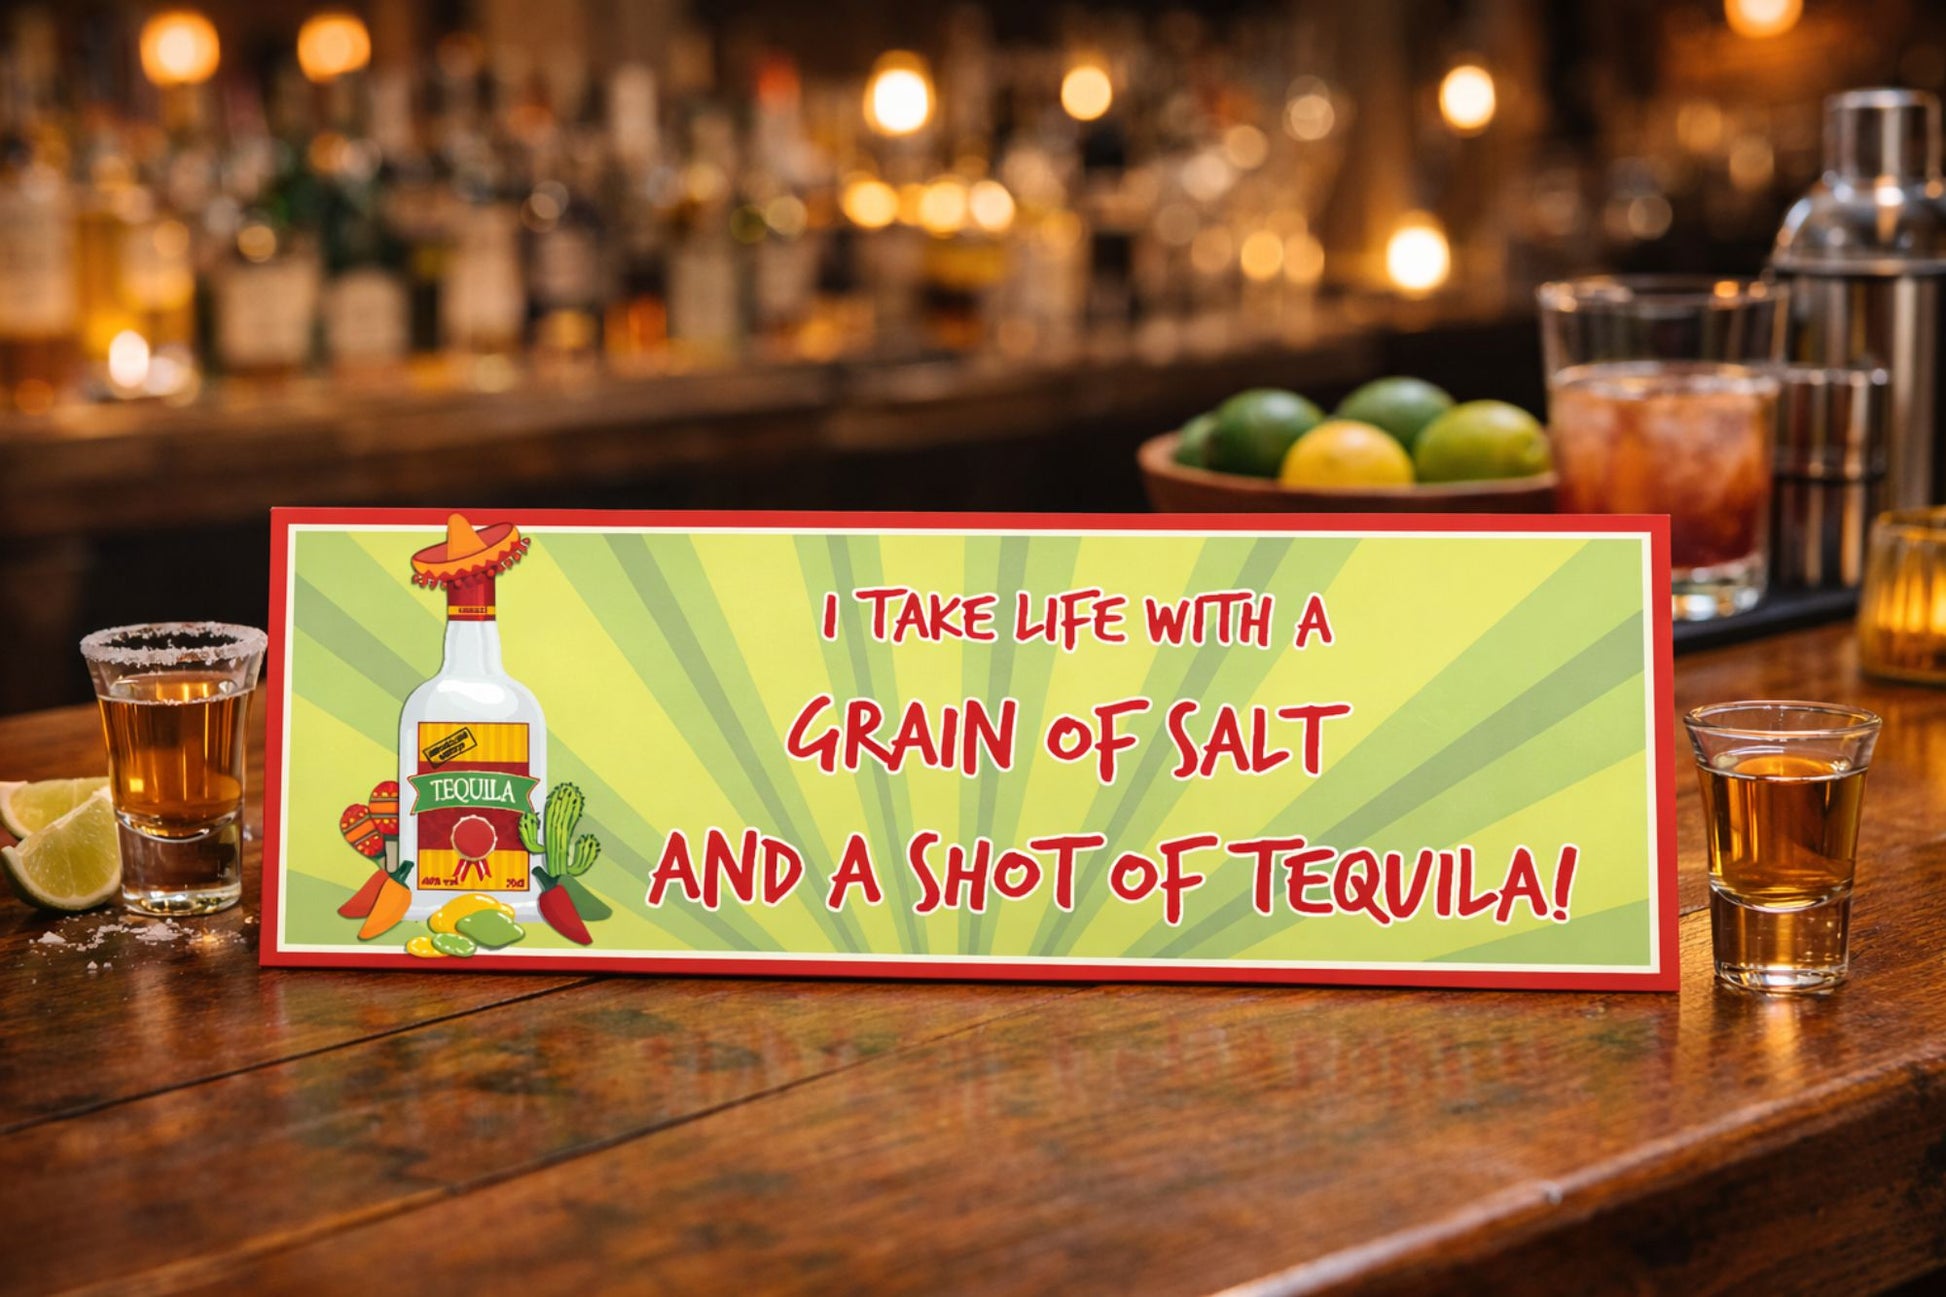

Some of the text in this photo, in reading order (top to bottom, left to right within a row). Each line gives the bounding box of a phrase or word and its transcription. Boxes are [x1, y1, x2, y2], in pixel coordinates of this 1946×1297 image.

[823, 587, 1333, 652] I TAKE LIFE WITH A
[786, 694, 1352, 784] GRAIN OF SALT
[429, 777, 516, 804] TEQUILA
[647, 829, 1578, 925] AND A SHOT OF TEQUILA!
